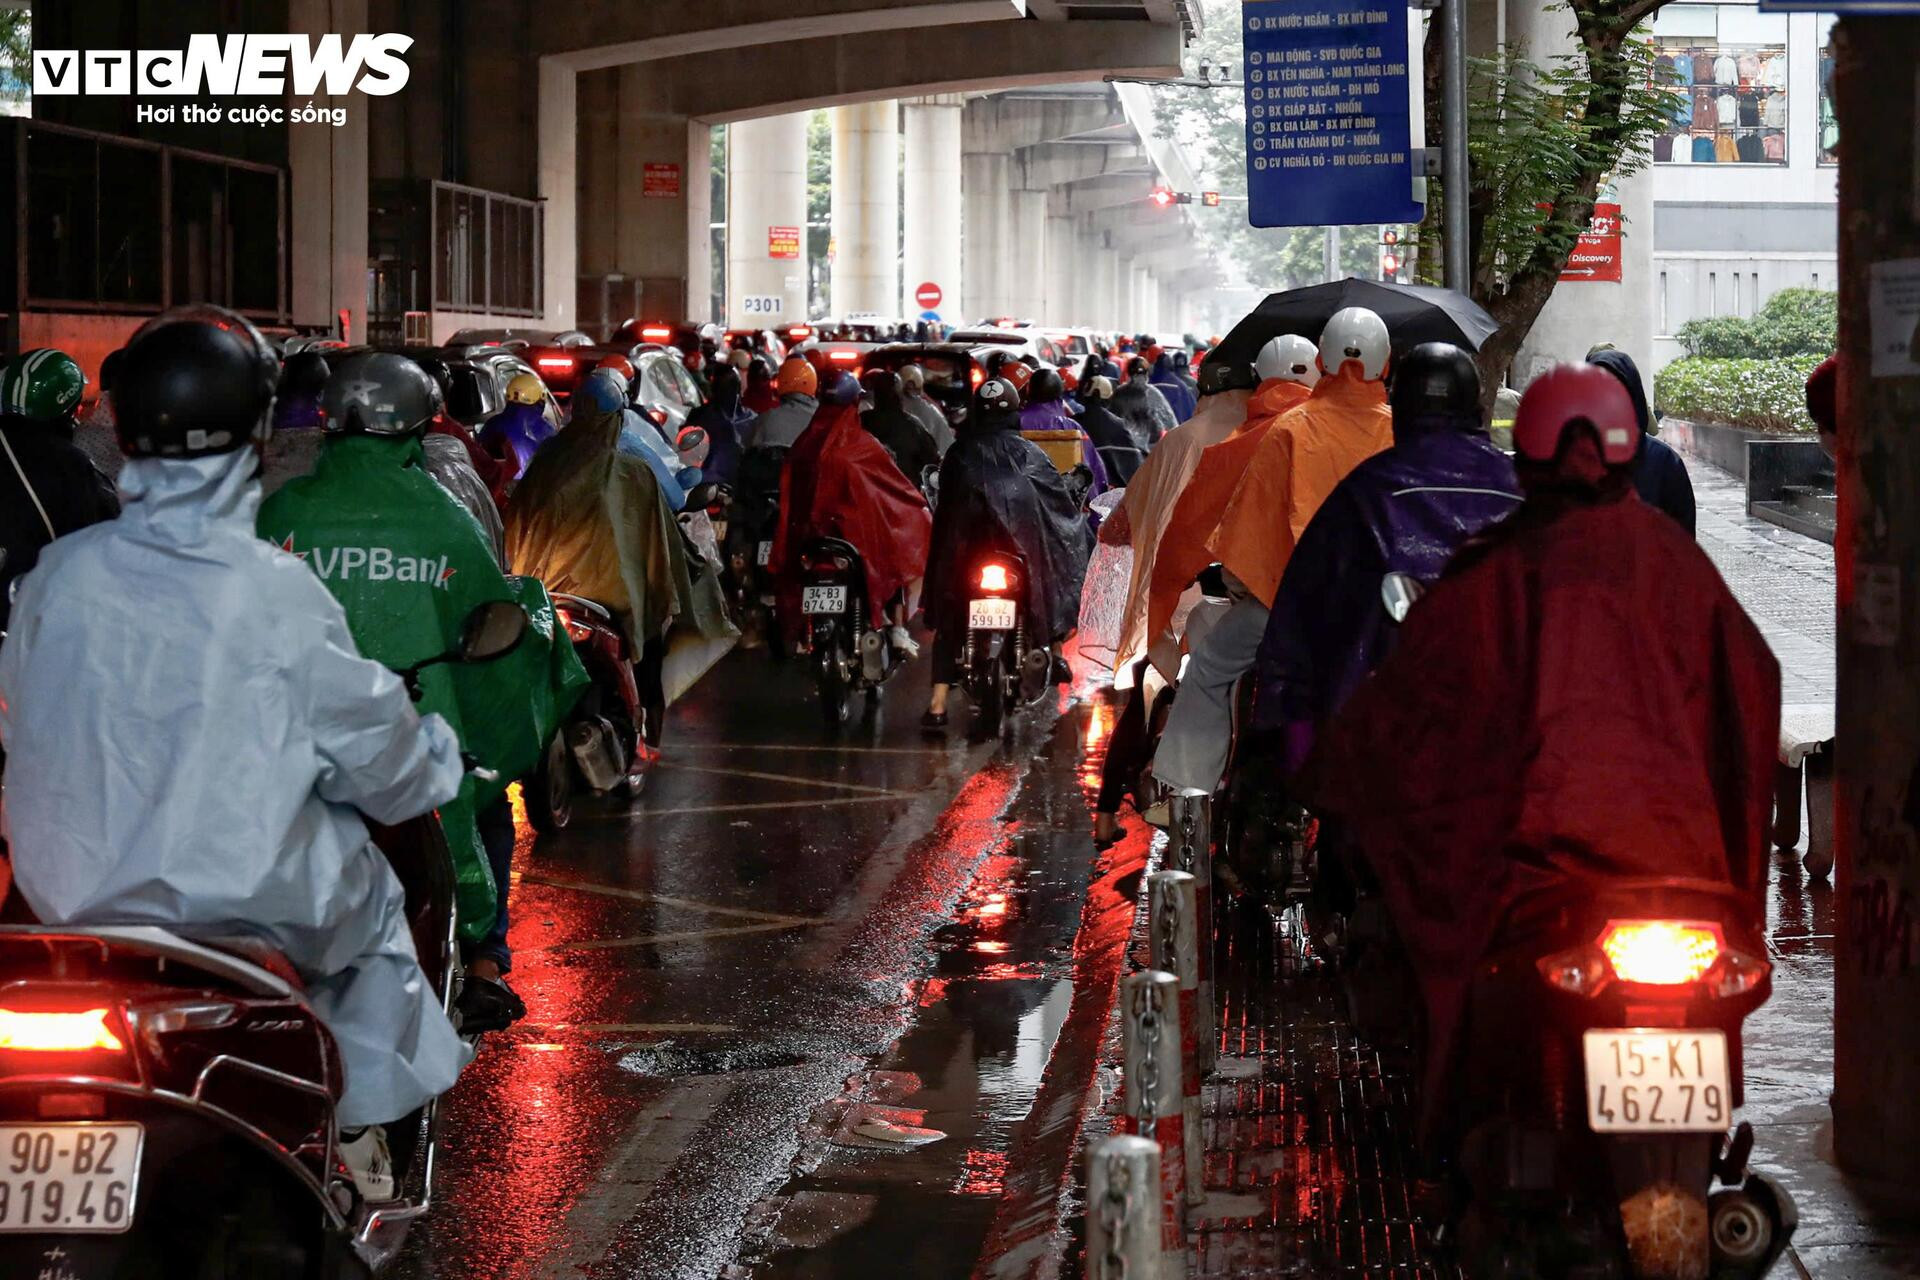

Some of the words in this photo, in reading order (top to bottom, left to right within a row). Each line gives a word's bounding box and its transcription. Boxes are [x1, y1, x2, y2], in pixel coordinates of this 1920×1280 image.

[1265, 17, 1277, 28] BX
[1337, 13, 1349, 25] BX
[1266, 51, 1284, 64] MAI
[1366, 46, 1382, 58] GIA
[1267, 70, 1279, 81] BX
[1331, 66, 1352, 78] NAM
[1383, 64, 1405, 76] LONG
[1268, 87, 1280, 99] BX
[1268, 105, 1281, 117] BX
[1284, 102, 1306, 116] GIÁP
[1270, 121, 1282, 132] BX
[1283, 121, 1298, 131] GIA
[1326, 119, 1337, 130] BX
[1269, 157, 1281, 168] CV
[1374, 153, 1389, 164] GIA
[1391, 152, 1405, 164] HN
[1585, 237, 1601, 245] Yoga
[1572, 253, 1613, 264] Discovery
[744, 298, 781, 312] P301
[312, 547, 449, 591] VPBank
[809, 588, 840, 599] 34-B3
[1609, 1039, 1704, 1078] 15-K1
[1597, 1084, 1723, 1123] 462.79
[9, 1132, 118, 1175] 90-B2
